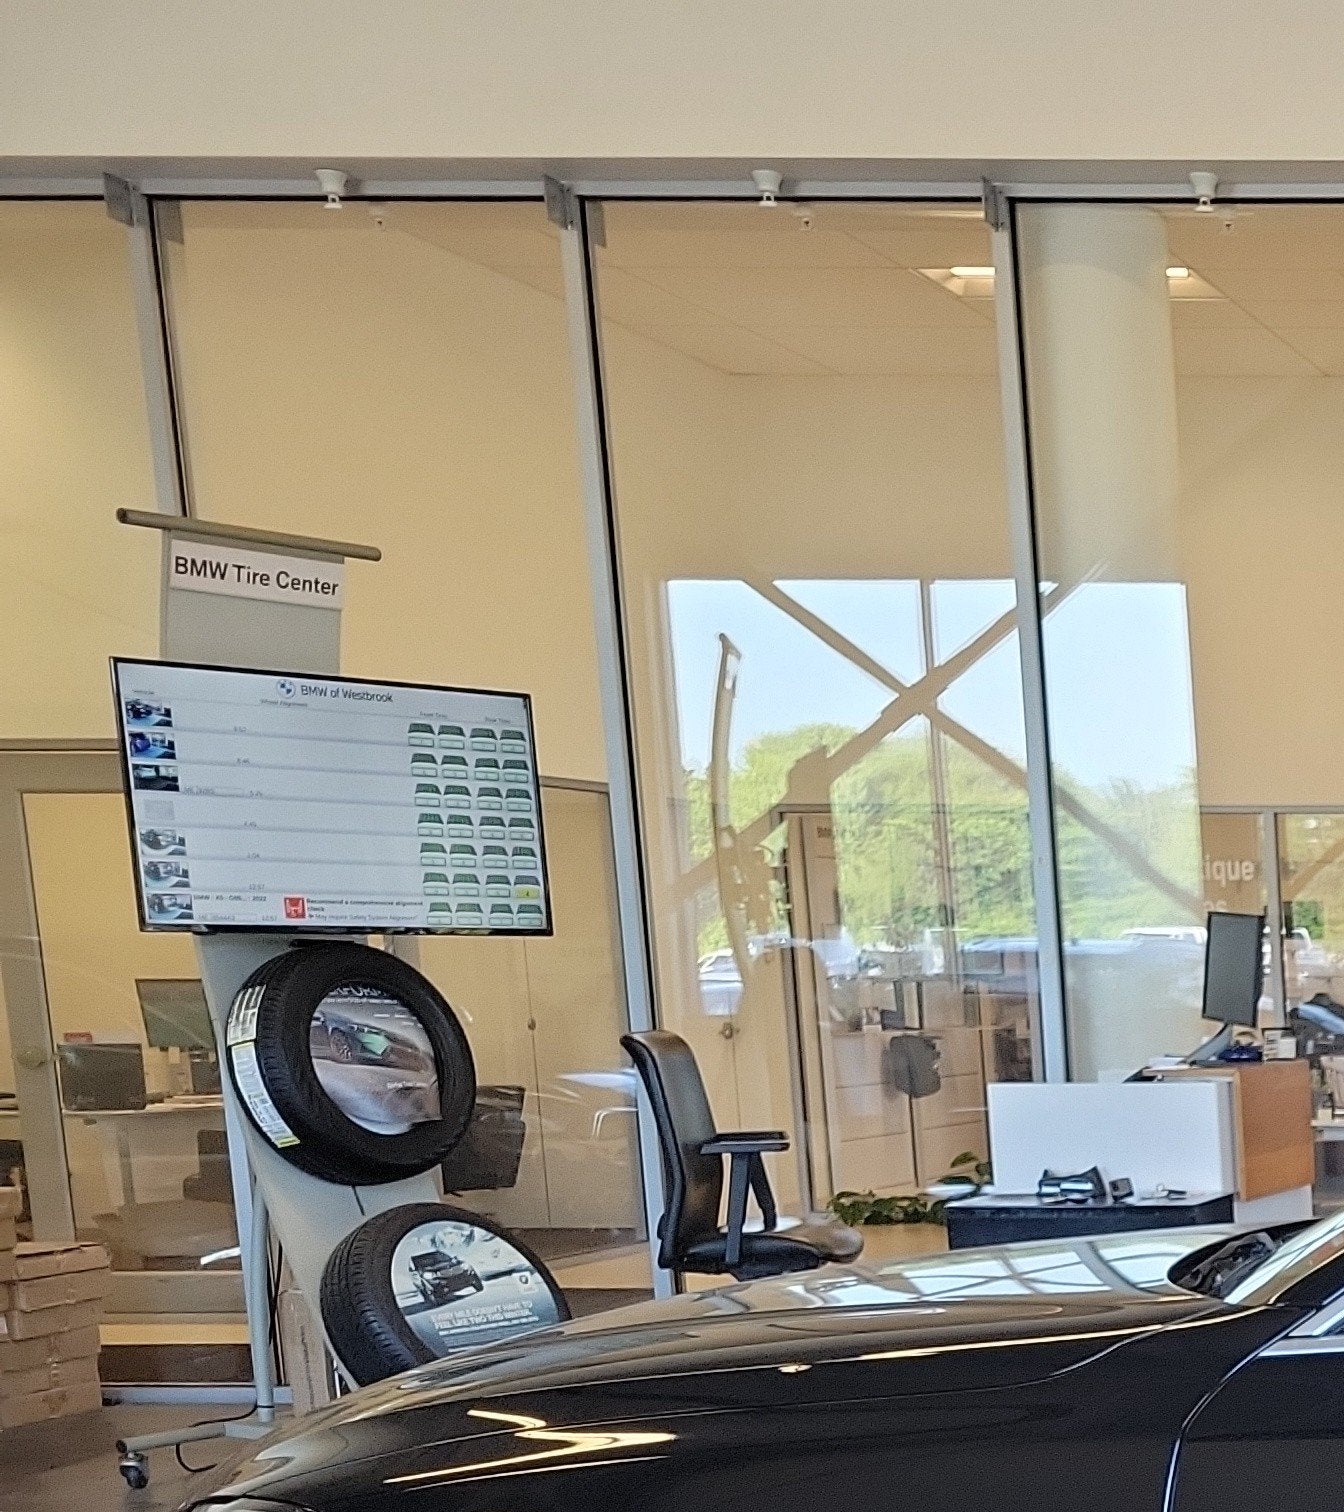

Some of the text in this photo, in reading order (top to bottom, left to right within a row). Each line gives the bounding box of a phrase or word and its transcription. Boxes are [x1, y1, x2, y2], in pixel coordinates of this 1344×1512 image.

[174, 555, 339, 596] BMW Tire Center
[301, 684, 393, 703] BMW of Westbrook
